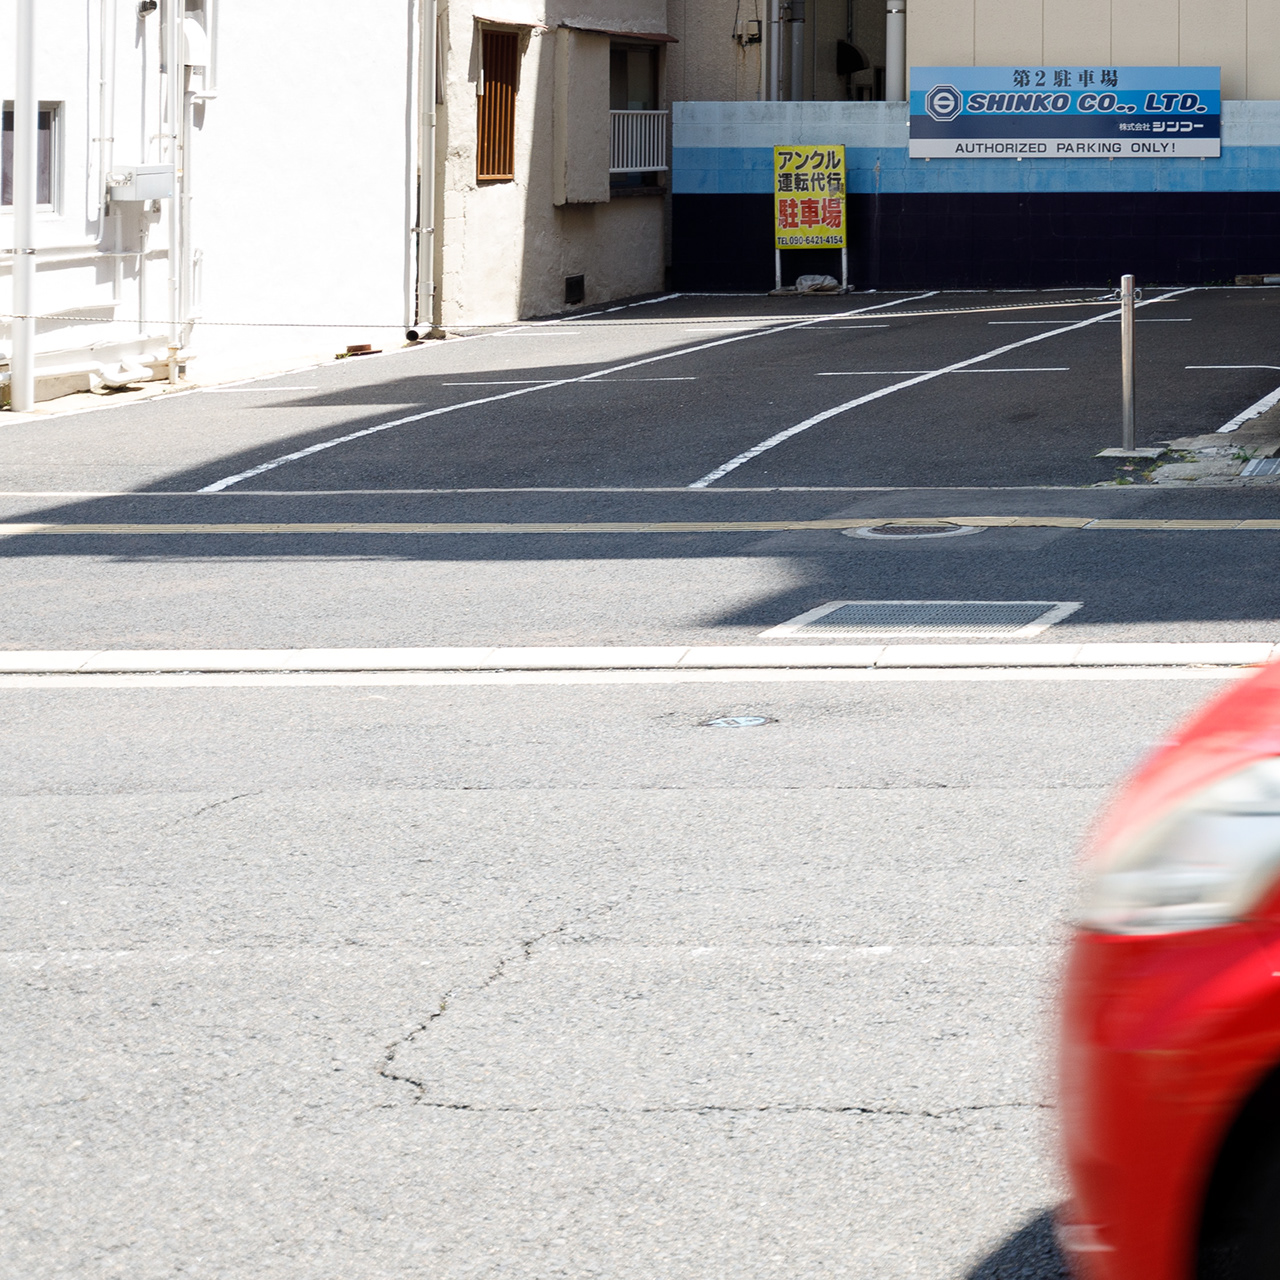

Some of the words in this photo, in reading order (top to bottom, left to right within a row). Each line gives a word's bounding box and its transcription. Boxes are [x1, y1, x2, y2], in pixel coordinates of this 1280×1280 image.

[1013, 69, 1119, 88] 第2駐車場
[966, 93, 1071, 113] SHINKO
[1077, 93, 1137, 114] CO.,
[1143, 93, 1208, 114] LTD.
[955, 142, 1047, 154] AUTHORIZED
[1056, 142, 1121, 154] PARKING
[1130, 142, 1176, 154] ONLY!
[778, 150, 842, 170] アンクル
[777, 172, 842, 192] 運転代行
[778, 197, 842, 229] 駐車場
